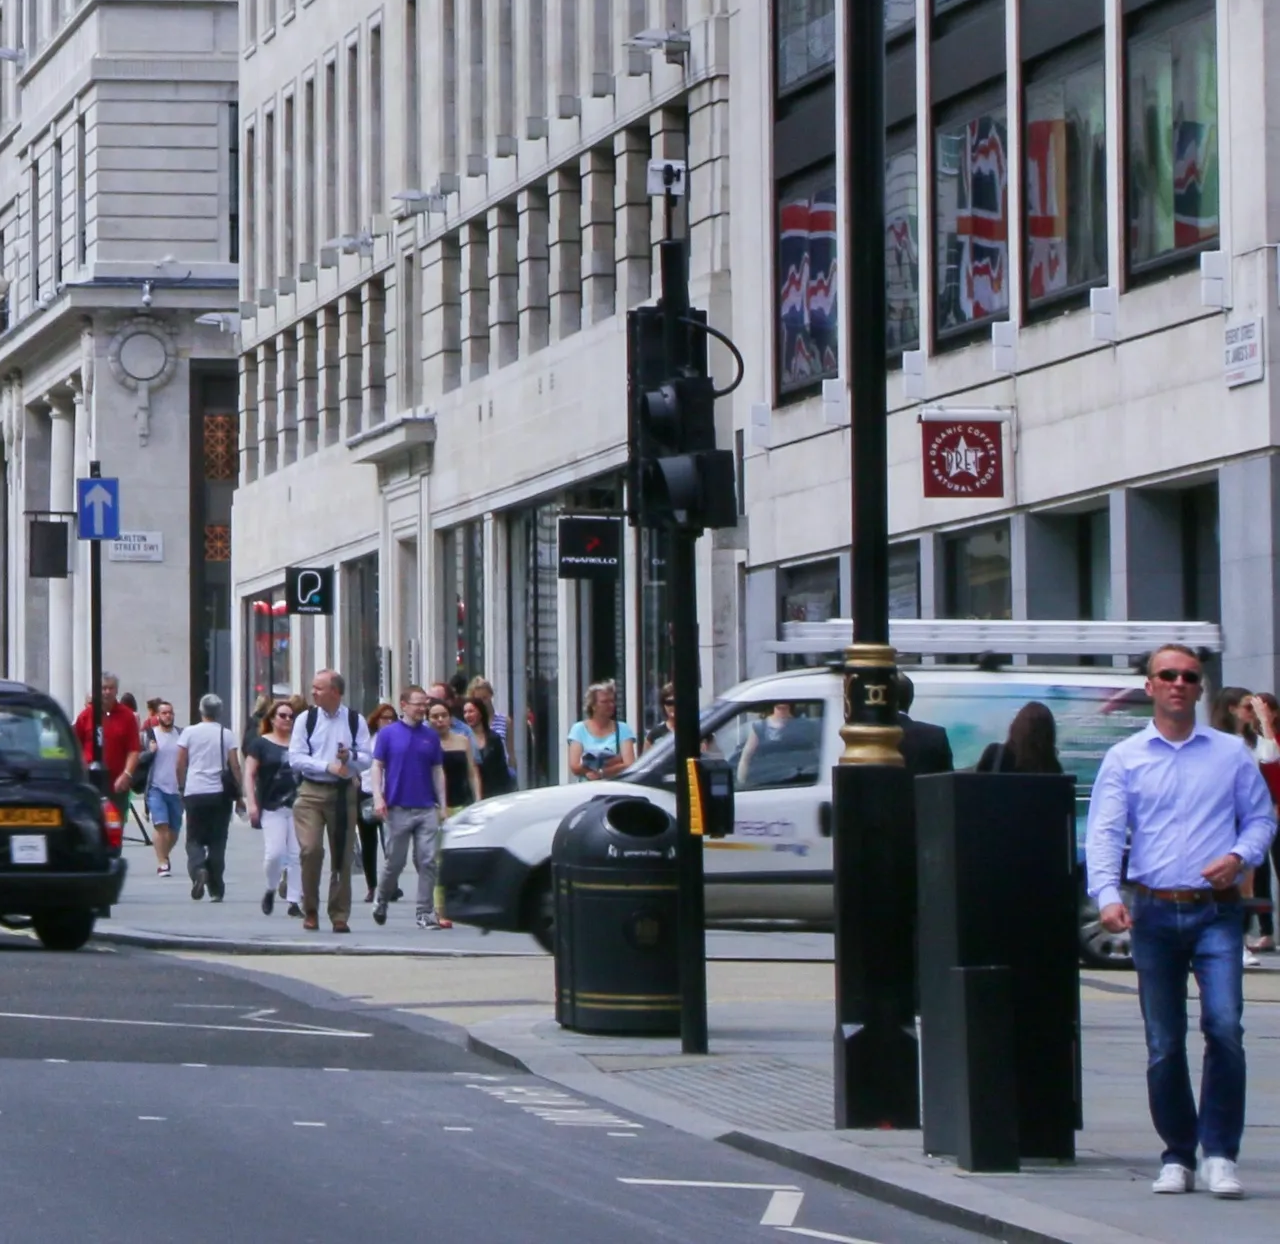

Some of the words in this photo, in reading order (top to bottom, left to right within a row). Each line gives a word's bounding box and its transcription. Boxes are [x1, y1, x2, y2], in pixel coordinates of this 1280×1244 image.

[929, 425, 963, 456] ORGANIC
[967, 426, 997, 456] COFFEE
[945, 447, 981, 473] PRET
[932, 468, 973, 493] NATURAL
[975, 467, 995, 488] FOOD
[561, 557, 618, 565] PINARELLO
